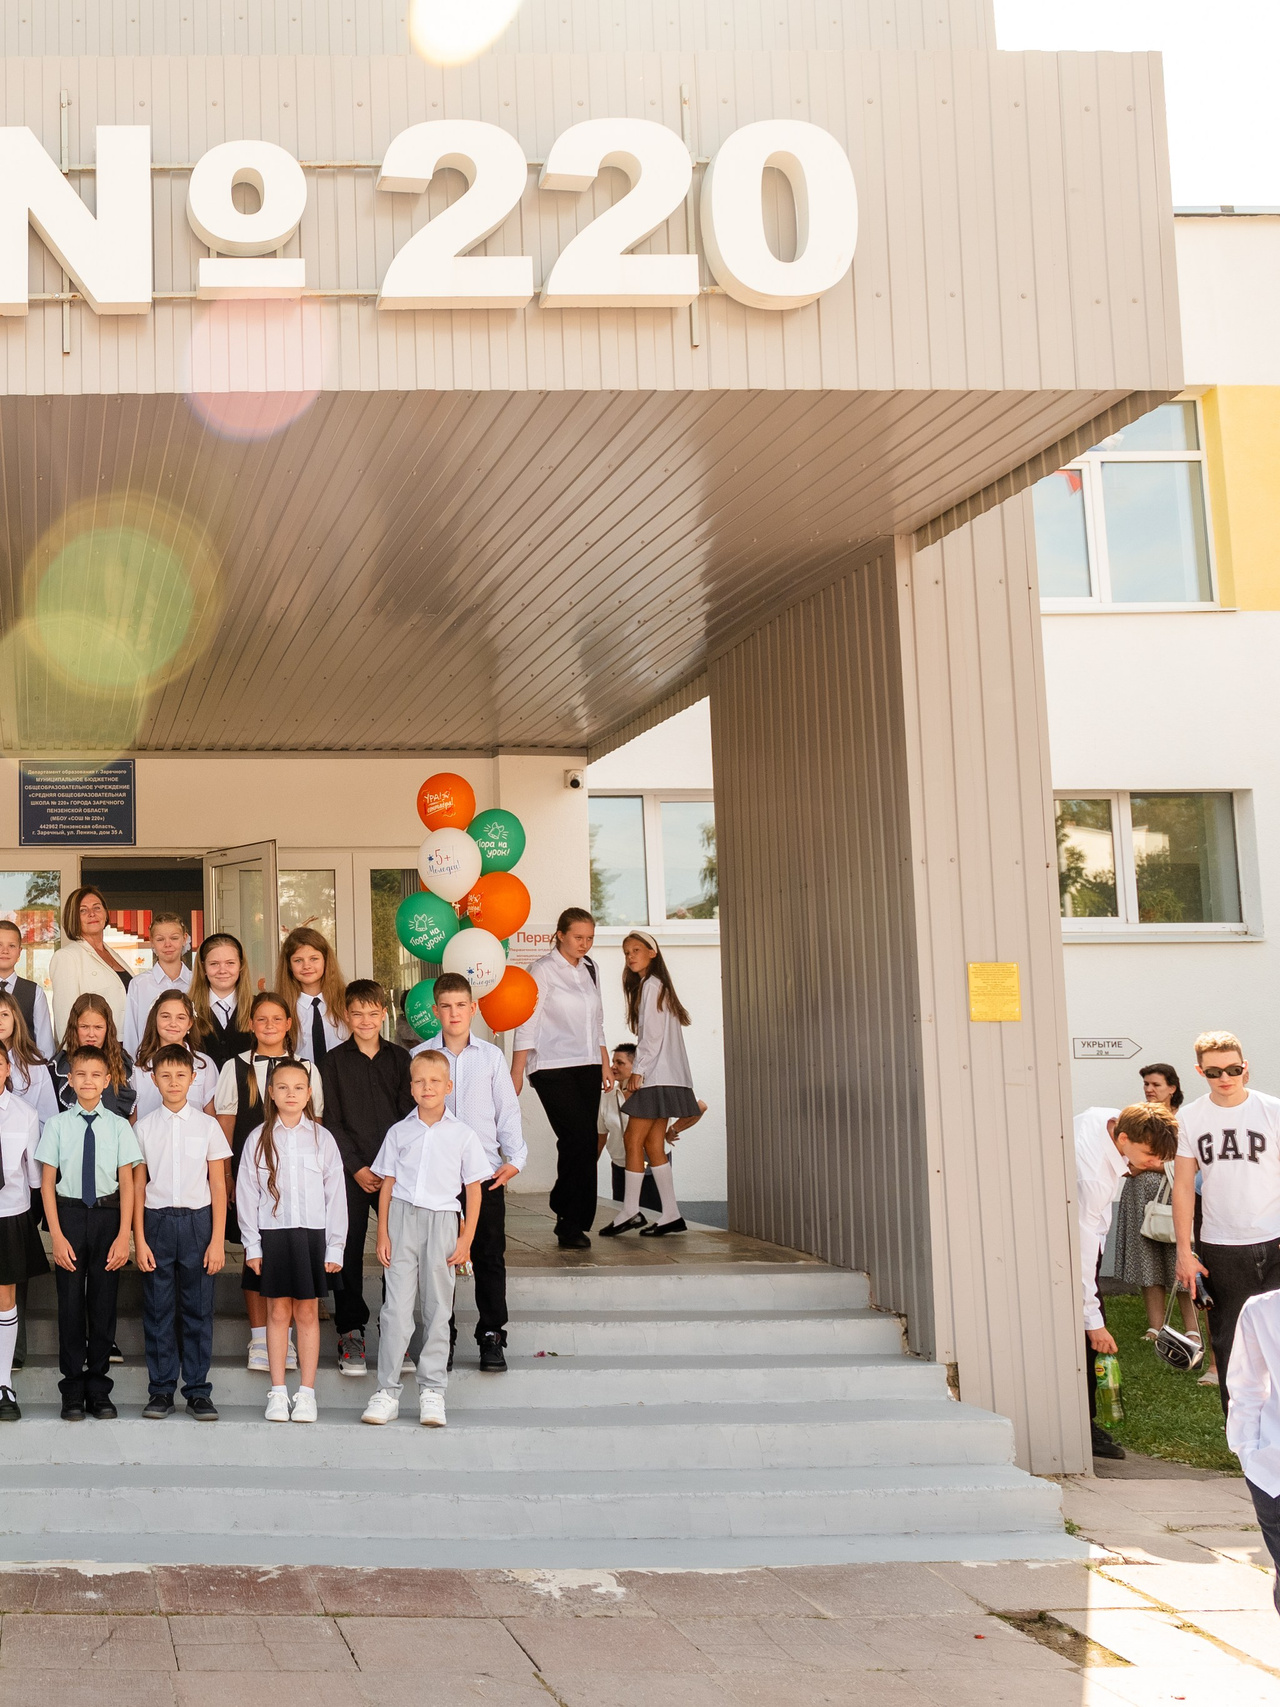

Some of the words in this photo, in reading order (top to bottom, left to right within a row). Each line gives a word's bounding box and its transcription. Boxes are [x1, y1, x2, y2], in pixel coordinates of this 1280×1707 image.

[375, 117, 859, 312] 220
[423, 791, 442, 804] УРА!
[476, 838, 495, 851] Пора
[434, 848, 451, 866] 5+
[486, 848, 511, 859] урок!
[410, 933, 429, 947] Пора
[429, 927, 440, 936] на
[425, 930, 446, 951] урок!
[476, 962, 491, 979] 5+
[1081, 1040, 1123, 1048] УКРЫТИЕ
[1197, 1128, 1267, 1166] GAP
